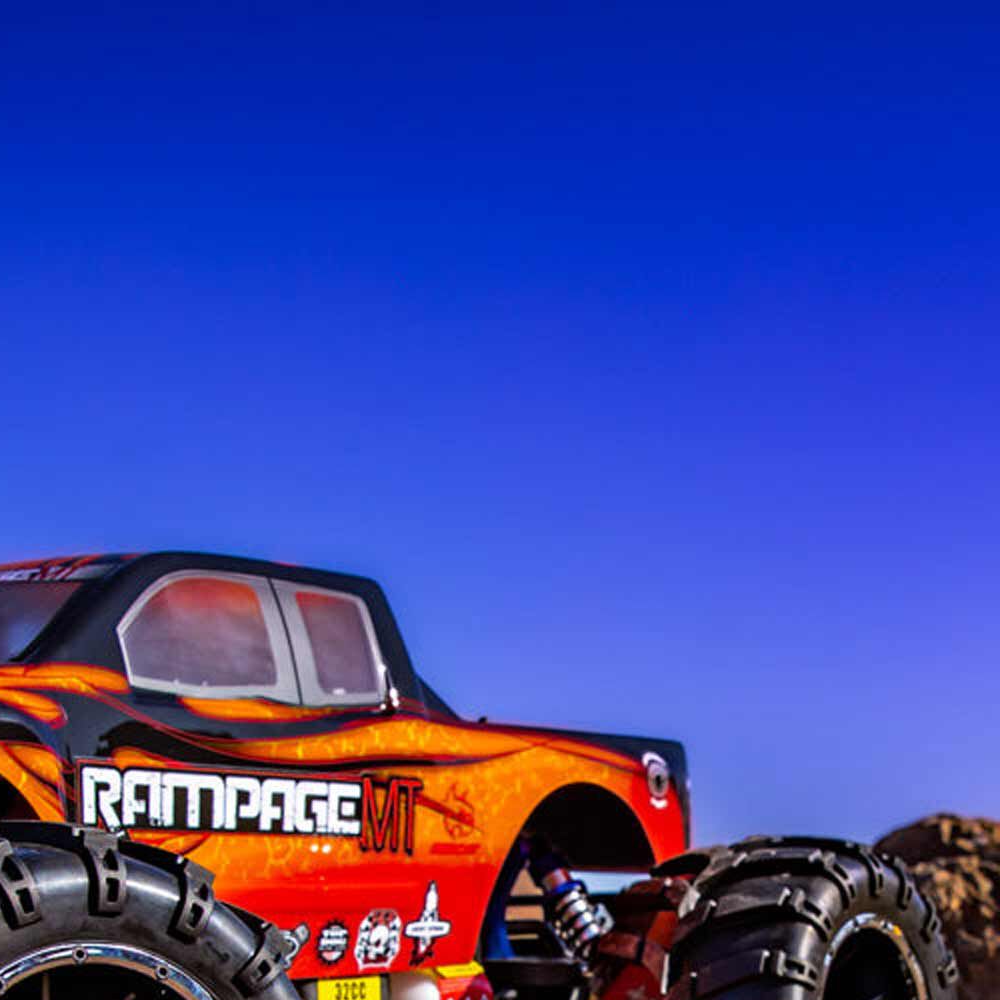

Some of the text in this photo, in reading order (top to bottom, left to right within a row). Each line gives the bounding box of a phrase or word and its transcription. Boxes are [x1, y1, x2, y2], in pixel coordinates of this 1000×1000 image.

[81, 765, 423, 854] RAMPAGE MT
[335, 981, 367, 1000] 32CC
